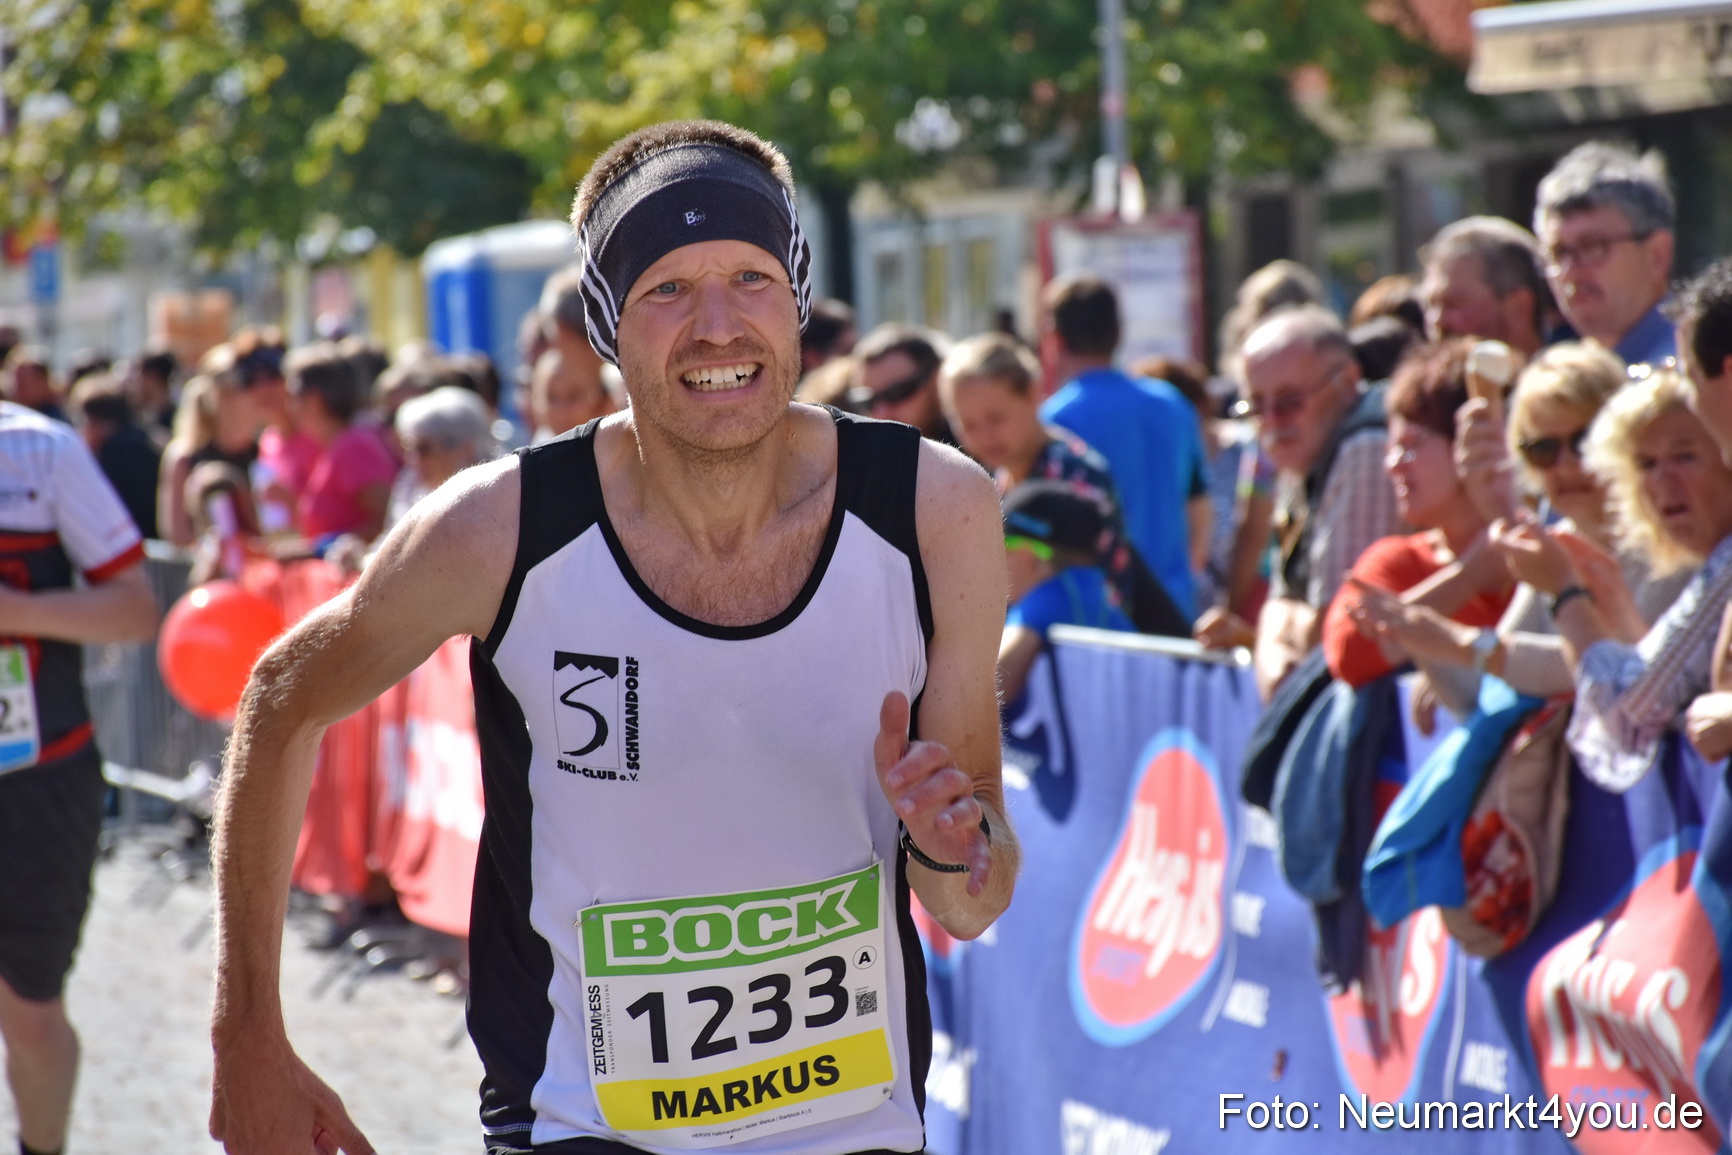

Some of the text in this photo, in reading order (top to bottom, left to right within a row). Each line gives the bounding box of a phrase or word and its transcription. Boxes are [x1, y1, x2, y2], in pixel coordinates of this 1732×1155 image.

[625, 656, 640, 771] SCHWANDORF
[557, 759, 617, 781] SKI-CLUB
[606, 883, 856, 963] BOCK
[858, 951, 871, 965] A
[604, 984, 612, 1026] ZEITMESSUNG
[625, 955, 849, 1064] 1233
[651, 1055, 840, 1121] MARKUS
